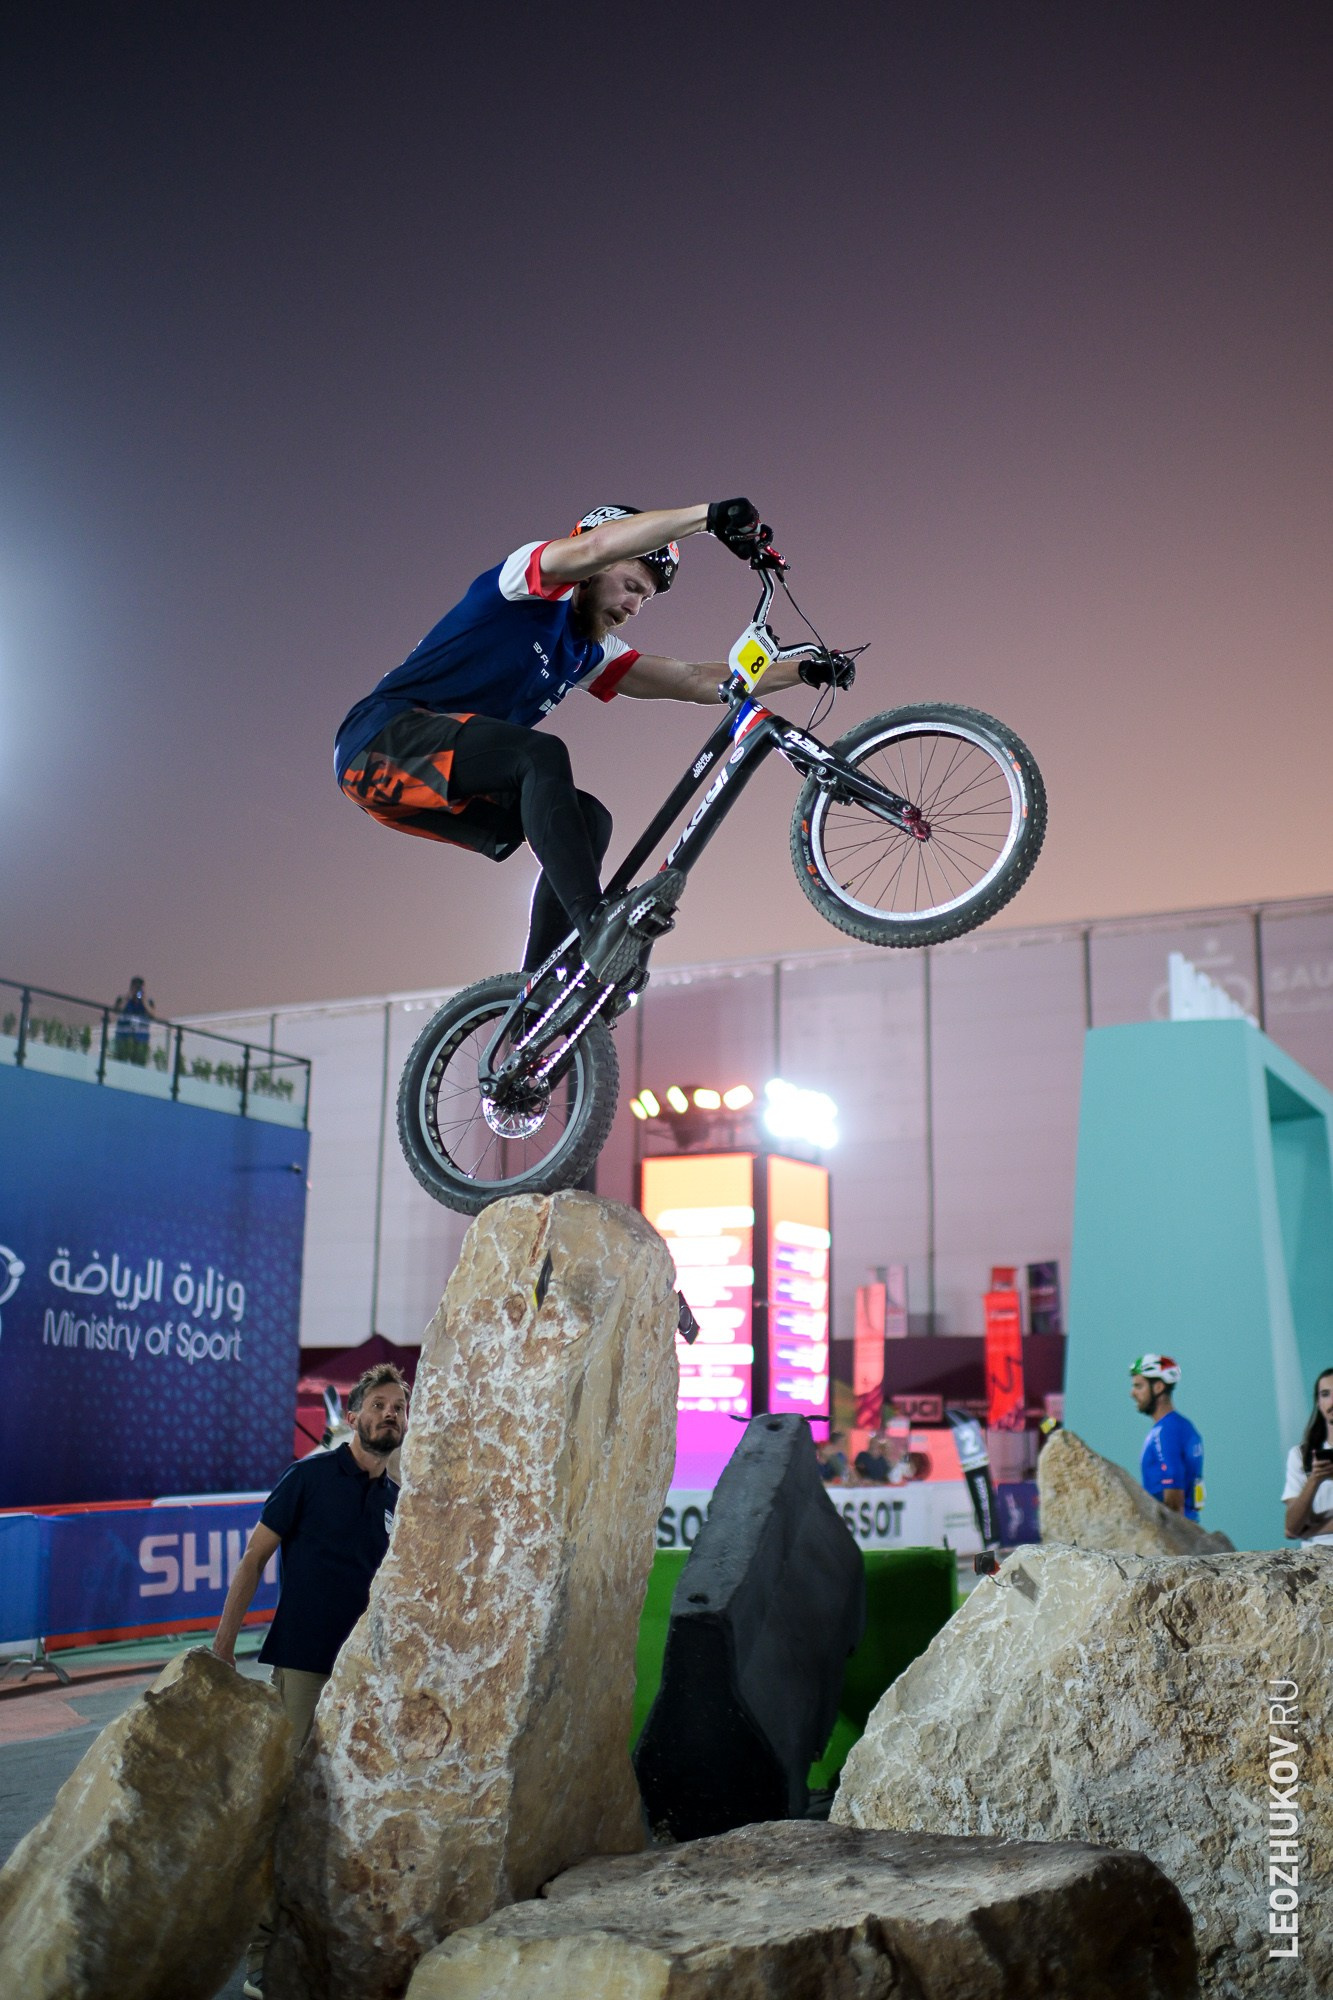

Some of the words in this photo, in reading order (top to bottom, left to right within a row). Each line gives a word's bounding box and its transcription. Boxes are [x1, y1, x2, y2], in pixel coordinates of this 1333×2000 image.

[751, 656, 764, 674] 8
[49, 1247, 163, 1311] الرياضة
[173, 1262, 245, 1322] وزارة
[43, 1308, 140, 1360] Ministry
[145, 1321, 173, 1355] of
[176, 1322, 242, 1365] Sport
[958, 1427, 980, 1455] 2
